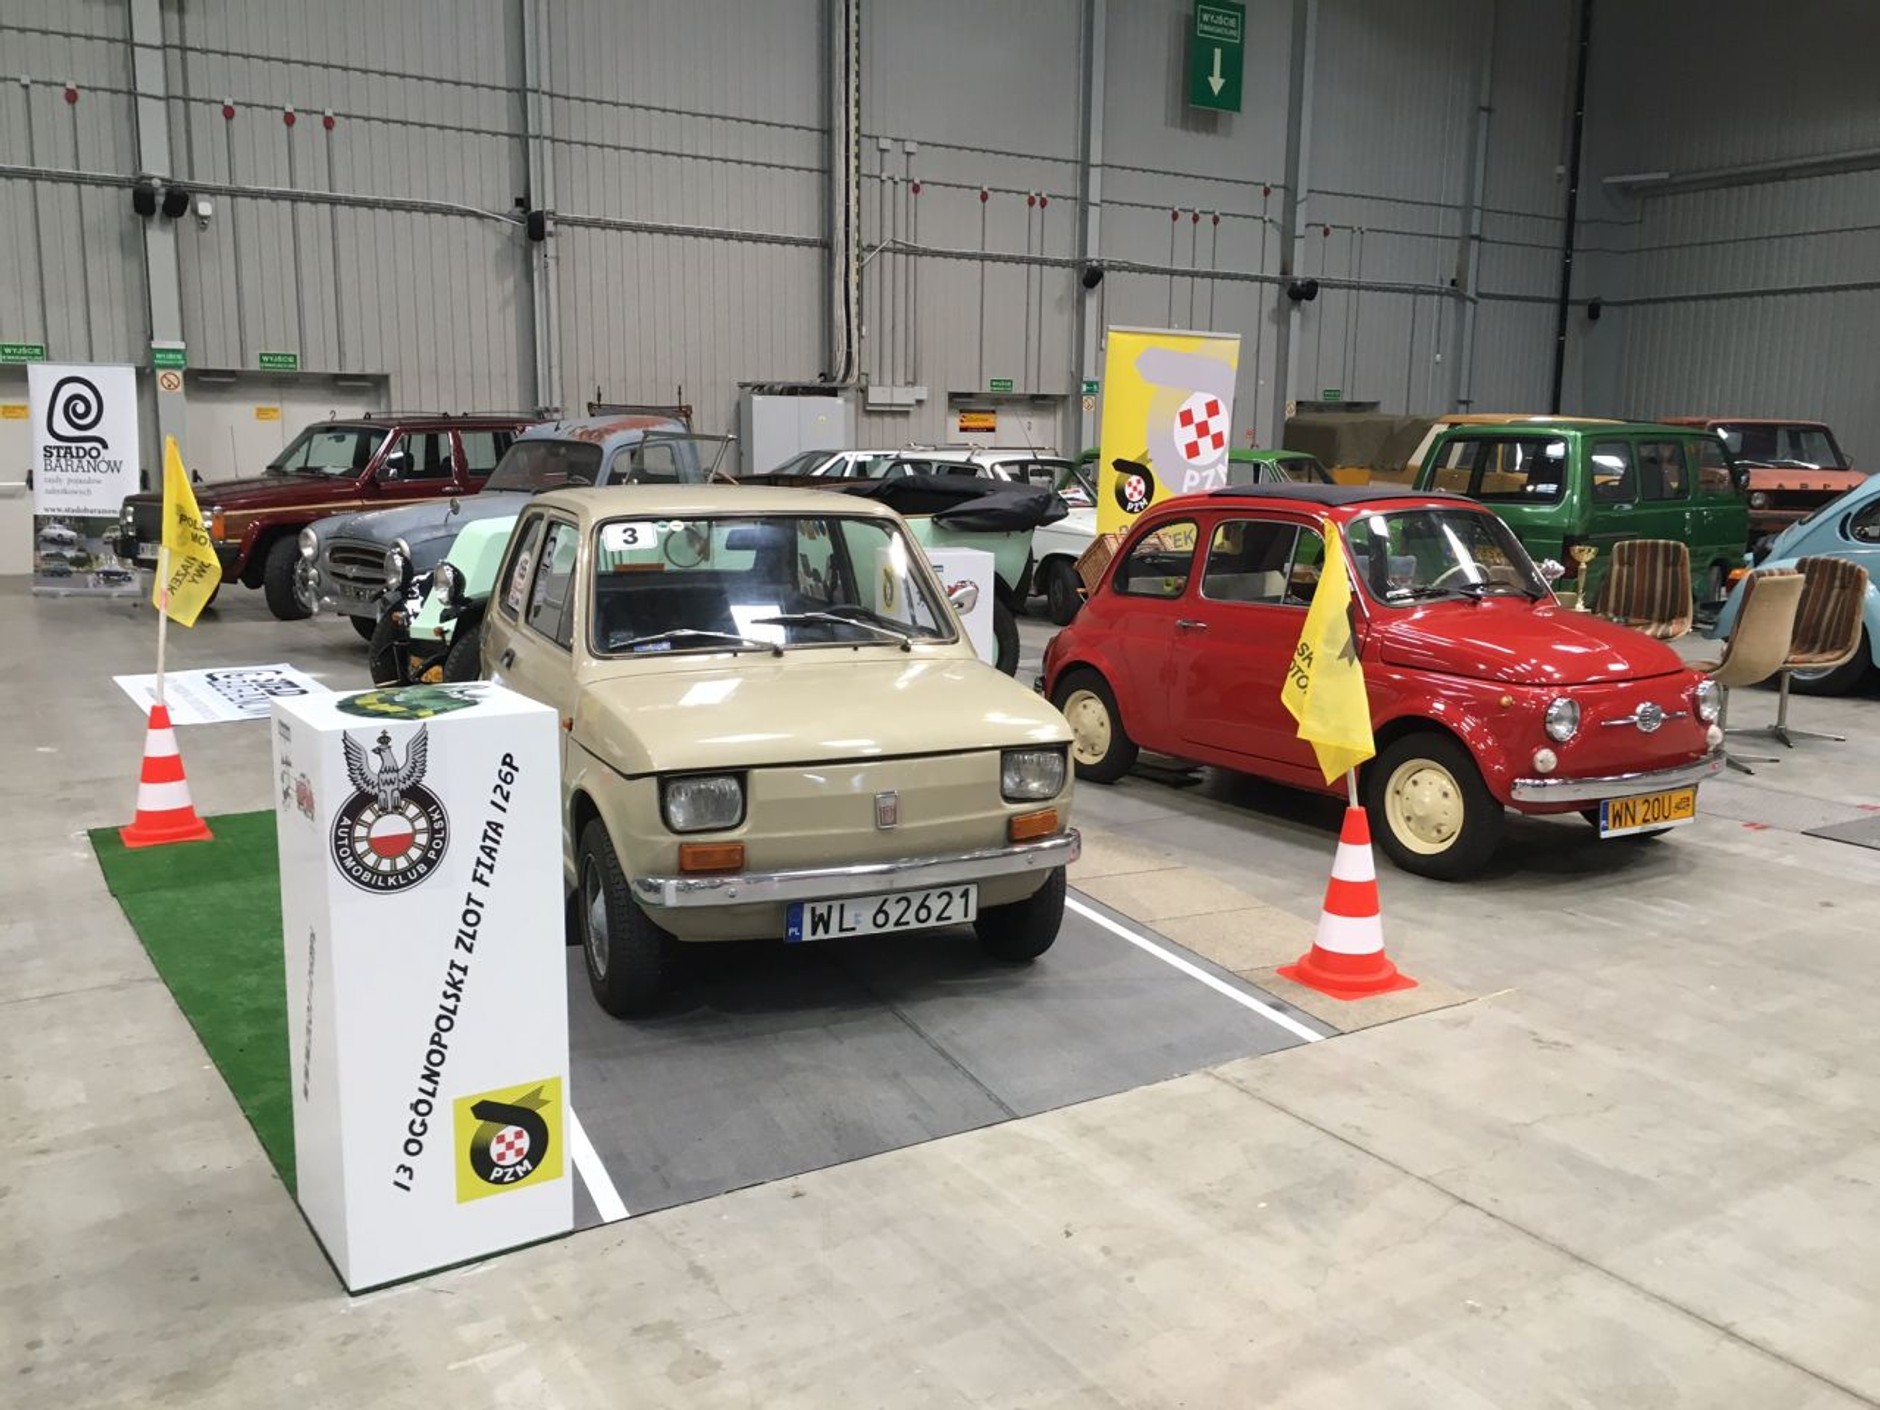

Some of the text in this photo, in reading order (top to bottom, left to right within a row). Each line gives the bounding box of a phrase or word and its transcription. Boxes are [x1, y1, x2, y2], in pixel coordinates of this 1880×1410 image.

[43, 445, 101, 459] STADO
[44, 457, 123, 474] BARANÓW
[1126, 497, 1148, 512] PZM
[191, 532, 212, 549] MO
[622, 527, 639, 545] 3
[1169, 529, 1194, 549] EK
[1290, 658, 1309, 694] TO
[1612, 800, 1635, 828] WN
[1642, 795, 1671, 822] 20U
[338, 805, 444, 886] AUTOMOBILKLUB POLSKI
[788, 888, 970, 936] PL WL 62621
[393, 752, 519, 1192] 13 OGÓLNOPOLSKI ZLOT FIATA 126P
[490, 1159, 532, 1181] PZM
